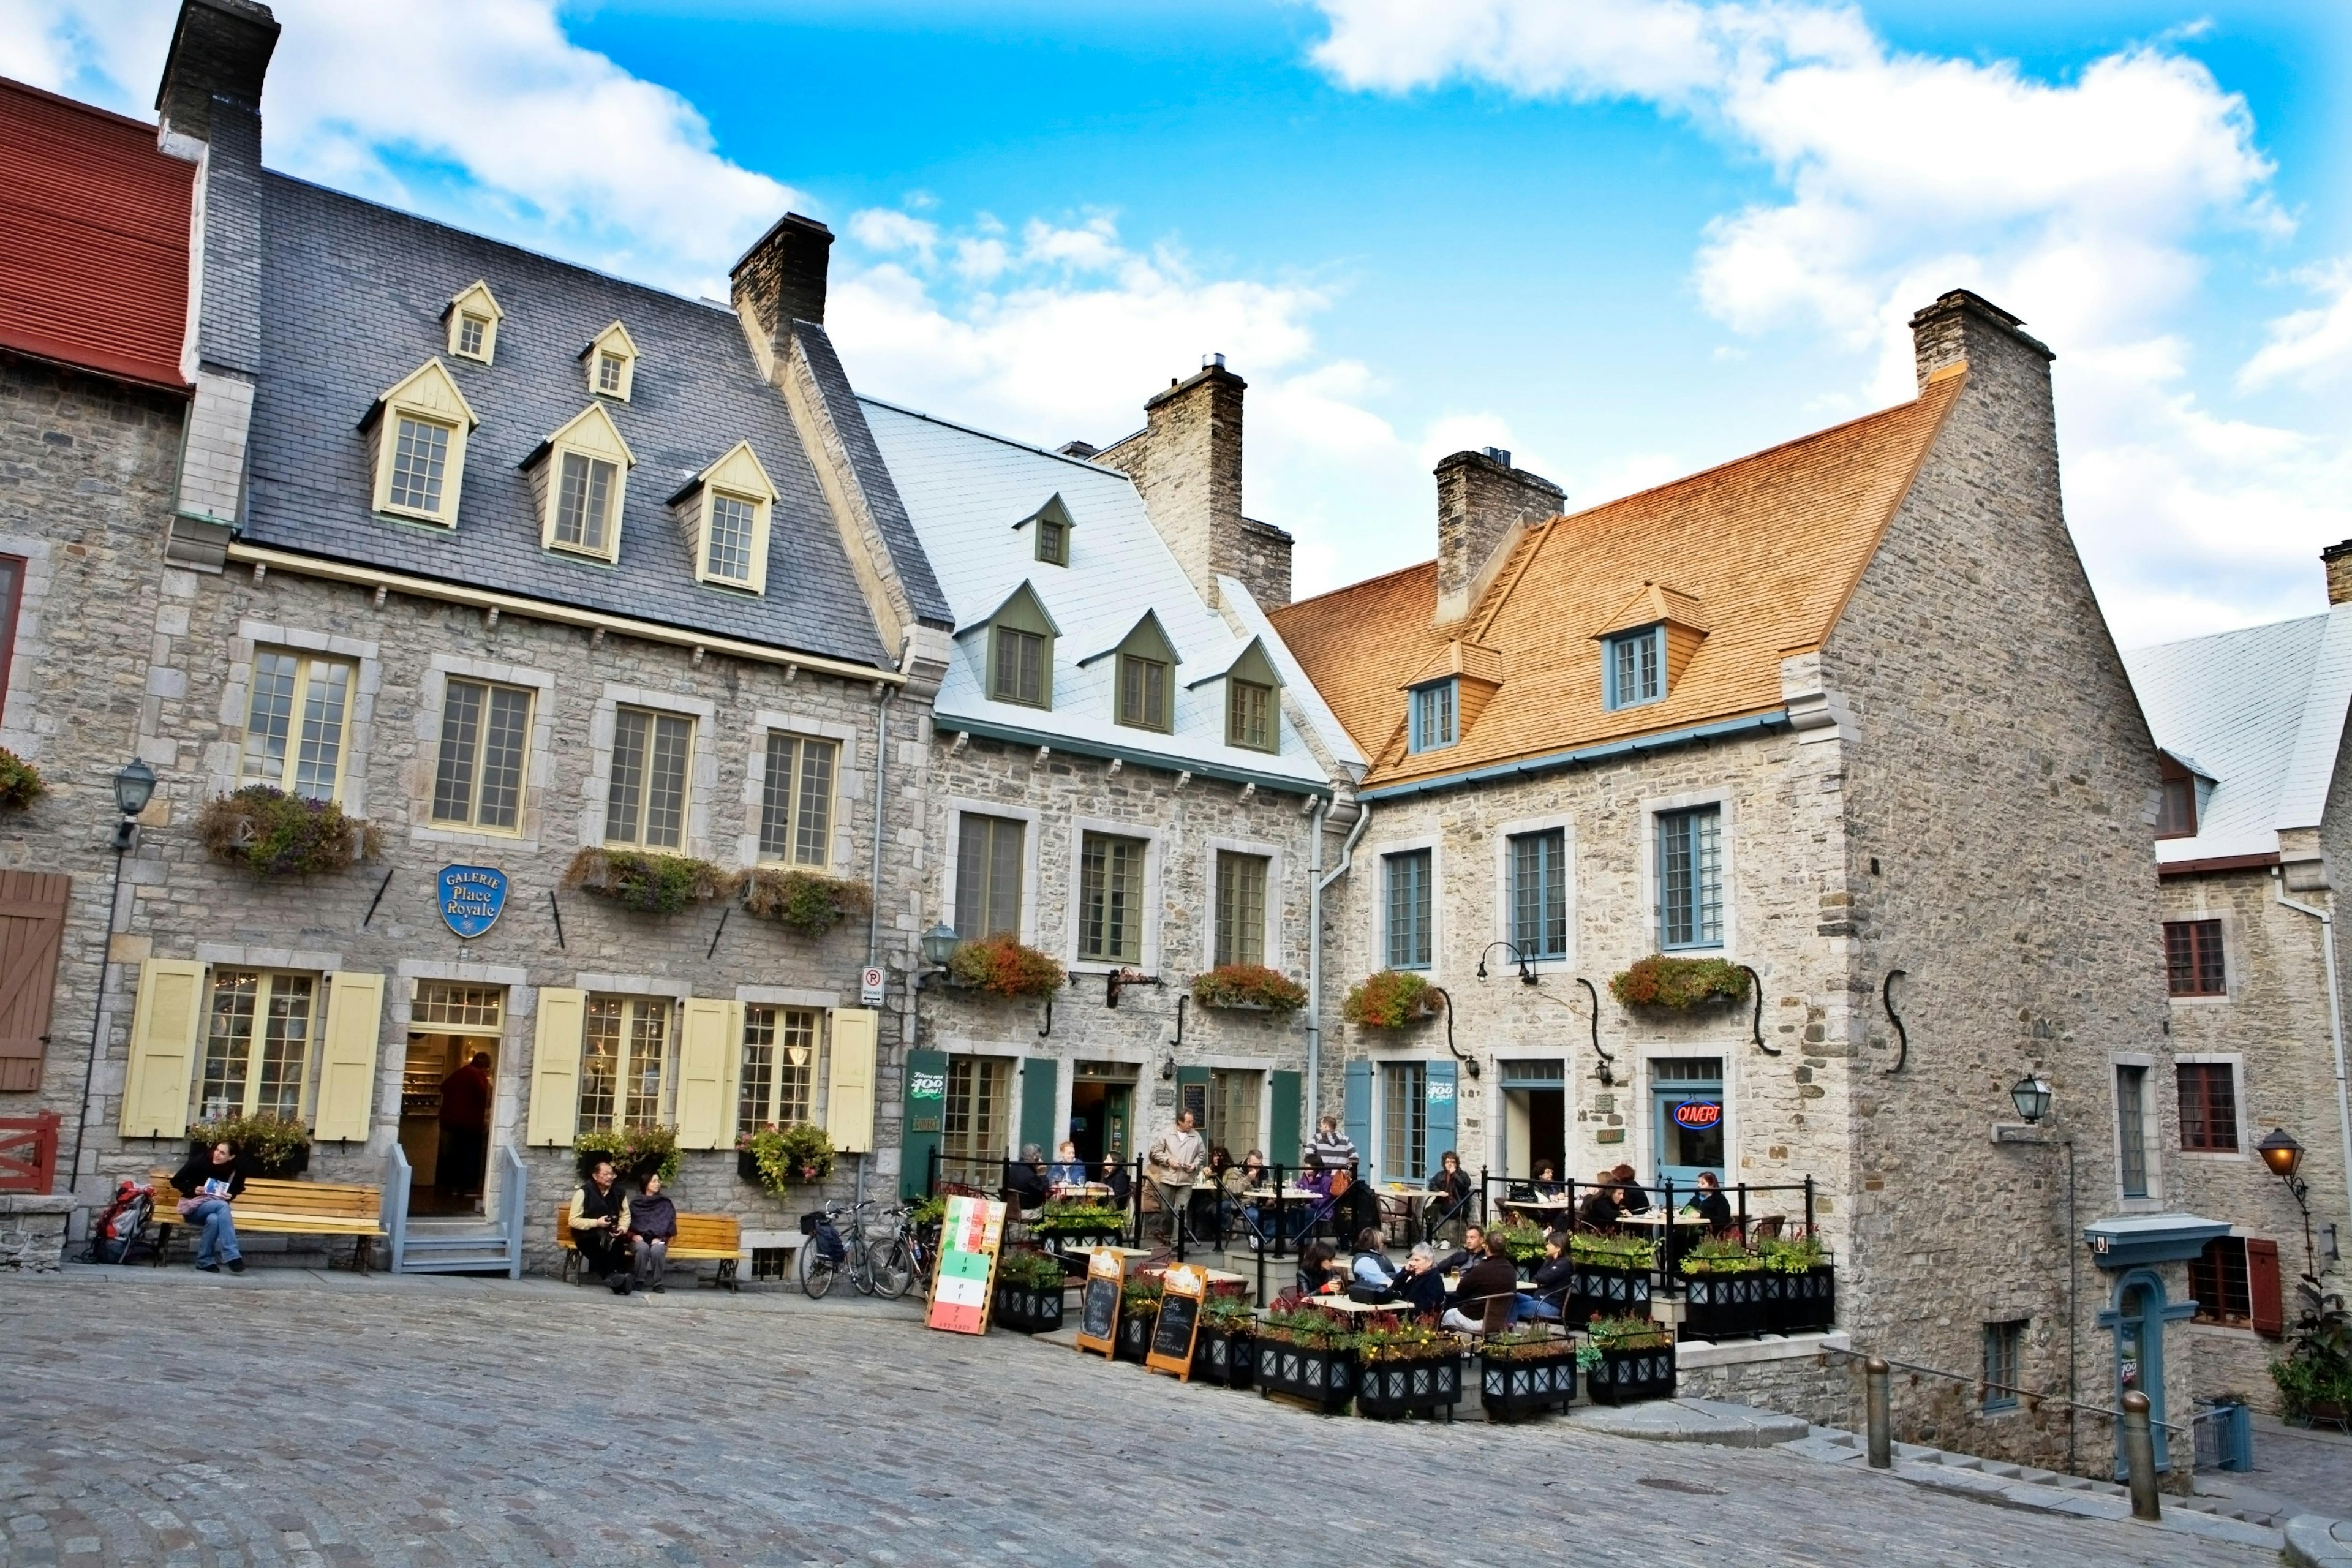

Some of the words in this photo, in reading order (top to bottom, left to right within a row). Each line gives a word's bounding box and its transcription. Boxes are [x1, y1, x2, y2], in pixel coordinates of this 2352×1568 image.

[446, 872, 500, 889] GALERIE
[453, 886, 492, 902] Place
[447, 900, 495, 918] Royale
[911, 1078, 943, 1093] 400
[1427, 1086, 1453, 1099] 400
[1678, 1106, 1721, 1121] OUVERT
[916, 1119, 937, 1129] OUVERT
